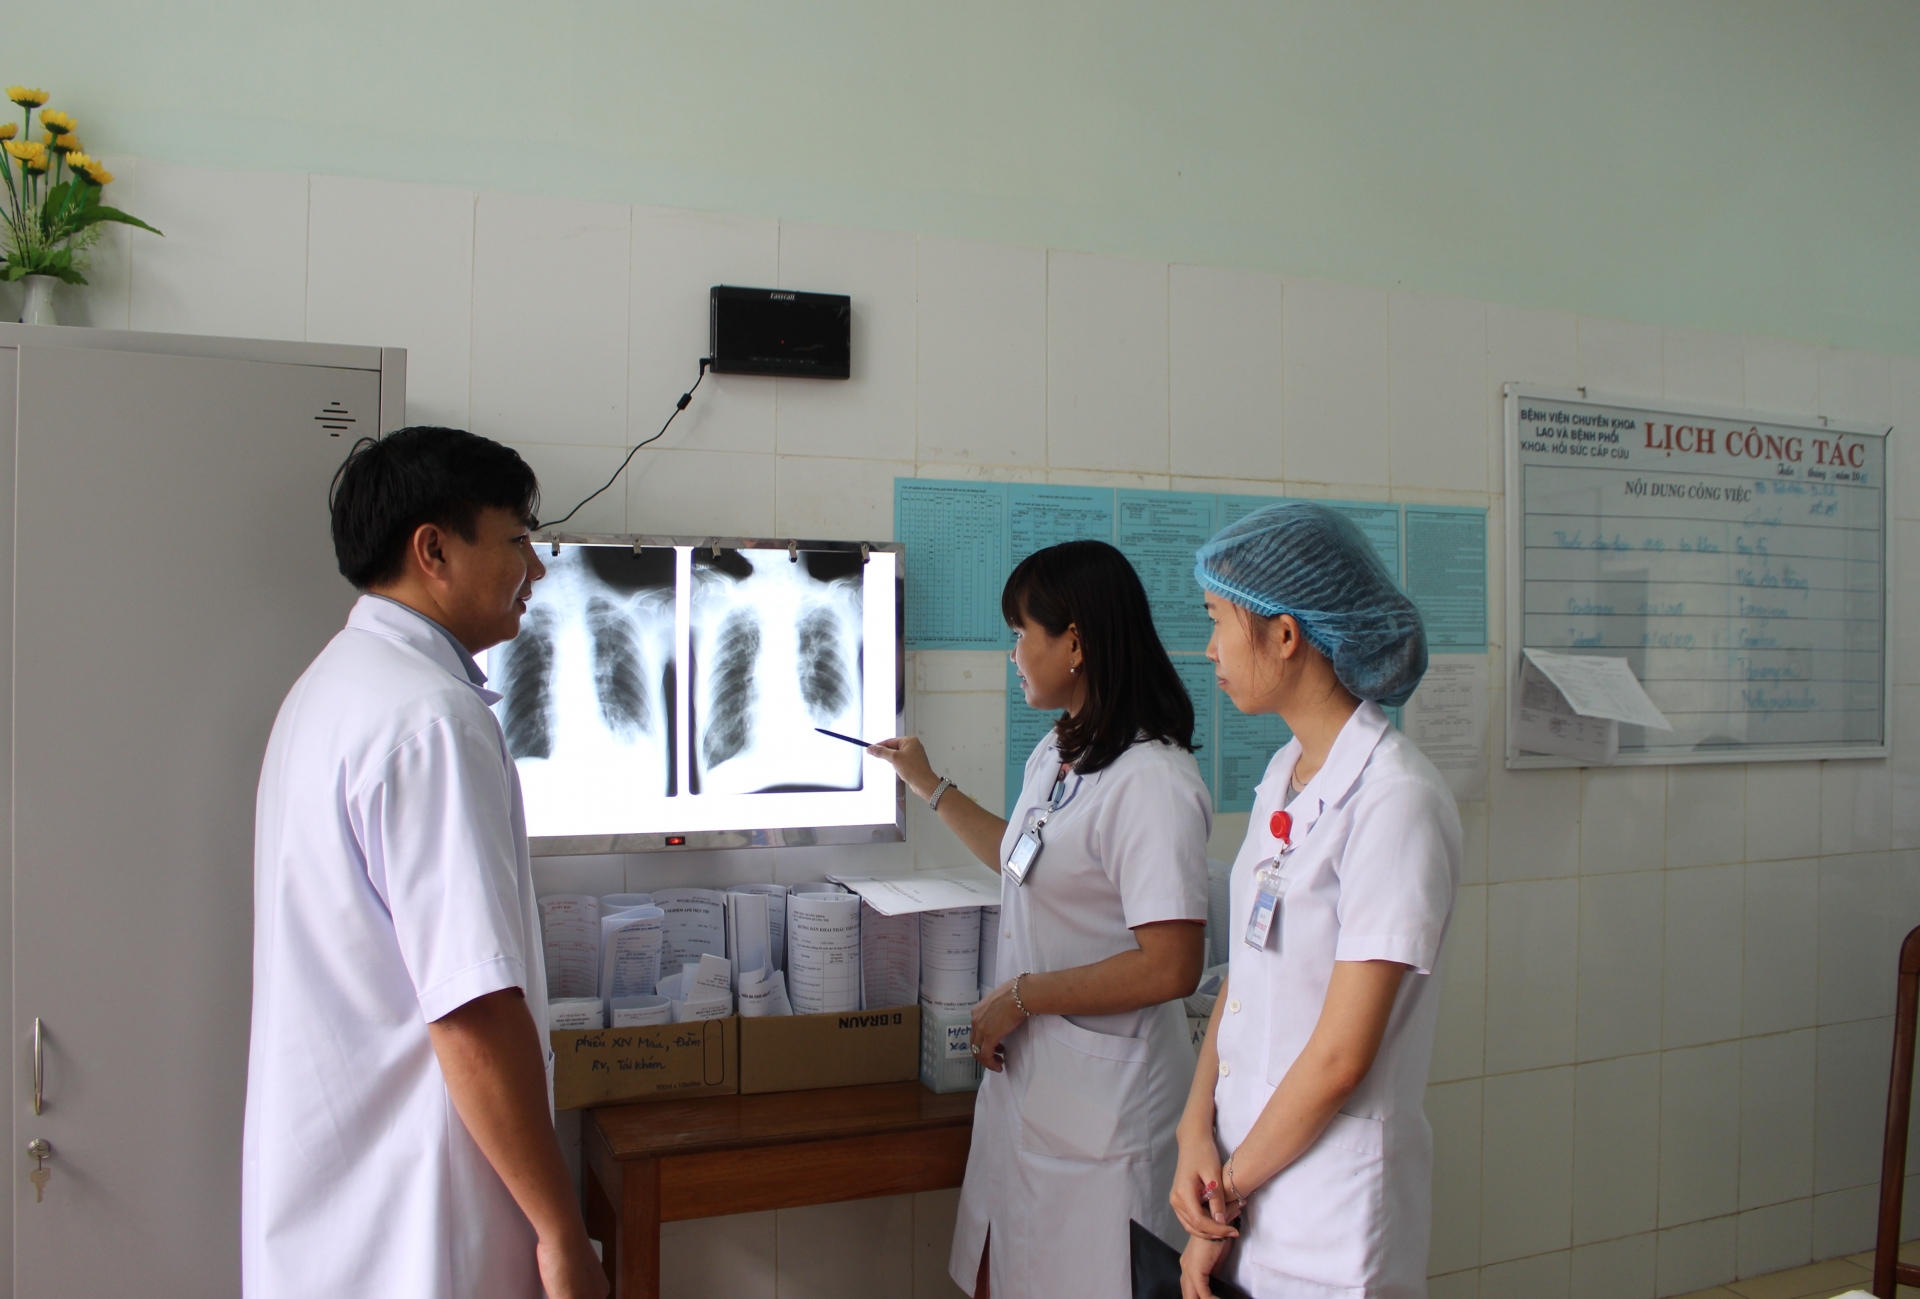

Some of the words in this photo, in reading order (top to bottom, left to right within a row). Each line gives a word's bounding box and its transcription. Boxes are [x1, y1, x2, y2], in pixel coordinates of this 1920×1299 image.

[1520, 408, 1546, 423] BỆNH
[1549, 411, 1570, 426] VIỆN
[1572, 414, 1609, 428] CHUYÊN
[1611, 418, 1636, 430] KHOA
[1535, 426, 1554, 438] LAO
[1556, 426, 1568, 439] VÀ
[1570, 428, 1596, 443] BỆNH
[1598, 428, 1619, 443] PHỔI
[1521, 441, 1549, 453] KHOA:
[1552, 441, 1567, 454] HỒI
[1570, 442, 1588, 456] SỨC
[1590, 444, 1608, 457] CẤP
[1610, 446, 1630, 459] CỨU
[1644, 422, 1716, 457] LỊCH
[1725, 426, 1803, 463] CÔNG
[1812, 434, 1865, 469] TÁC
[1624, 478, 1649, 498] NỘI
[1651, 482, 1686, 498] DUNG
[1688, 482, 1721, 500] CÔNG
[1724, 485, 1751, 504] VIỆC
[839, 1014, 889, 1029] BRAUN
[611, 1036, 633, 1049] XN
